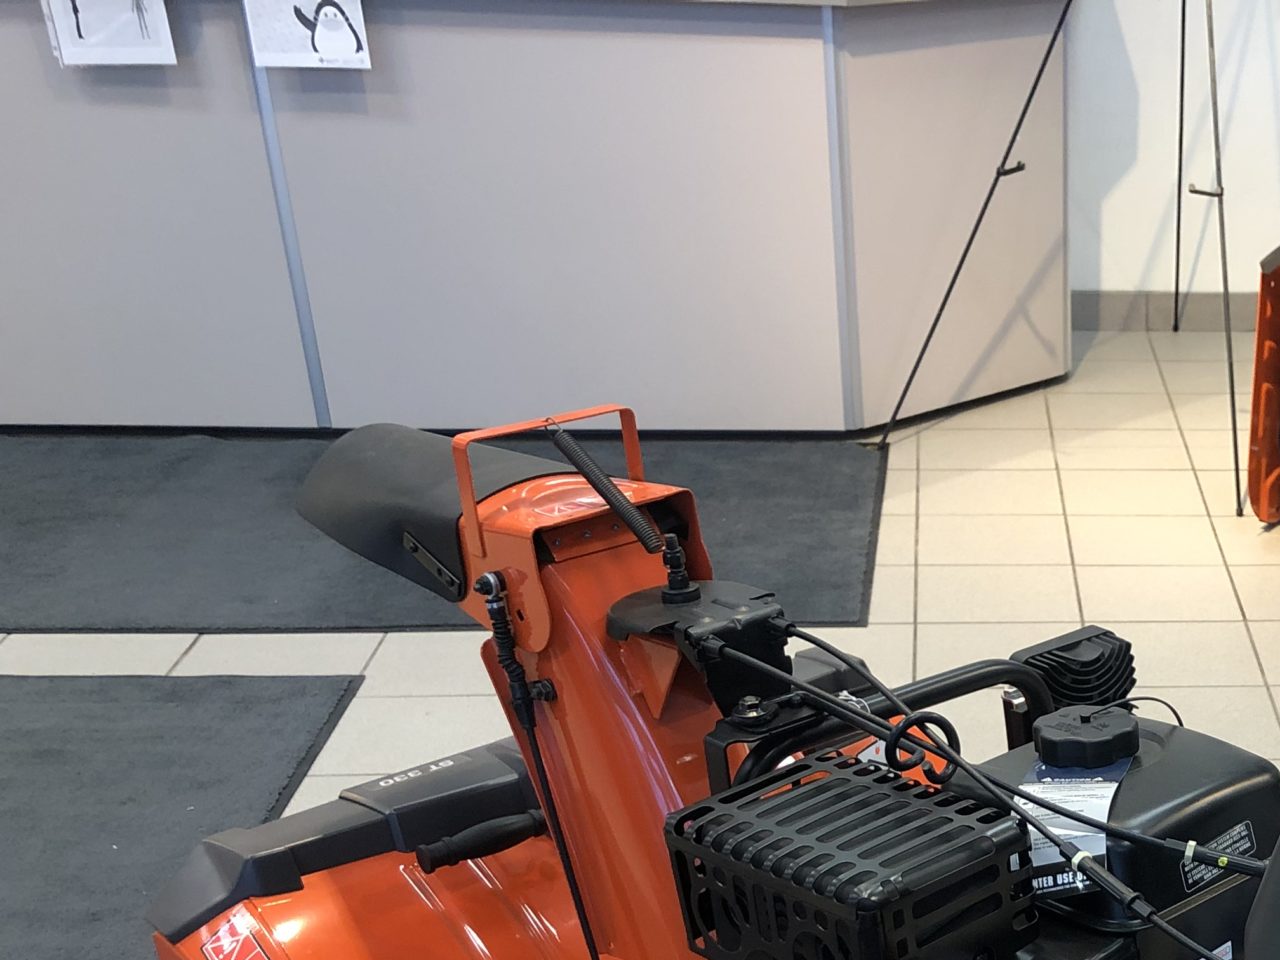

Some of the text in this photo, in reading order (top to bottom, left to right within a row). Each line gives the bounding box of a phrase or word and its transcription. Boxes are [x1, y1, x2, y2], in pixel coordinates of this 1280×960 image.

[378, 759, 454, 787] ST 330
[1032, 874, 1054, 889] NTER
[1057, 871, 1074, 885] USE
